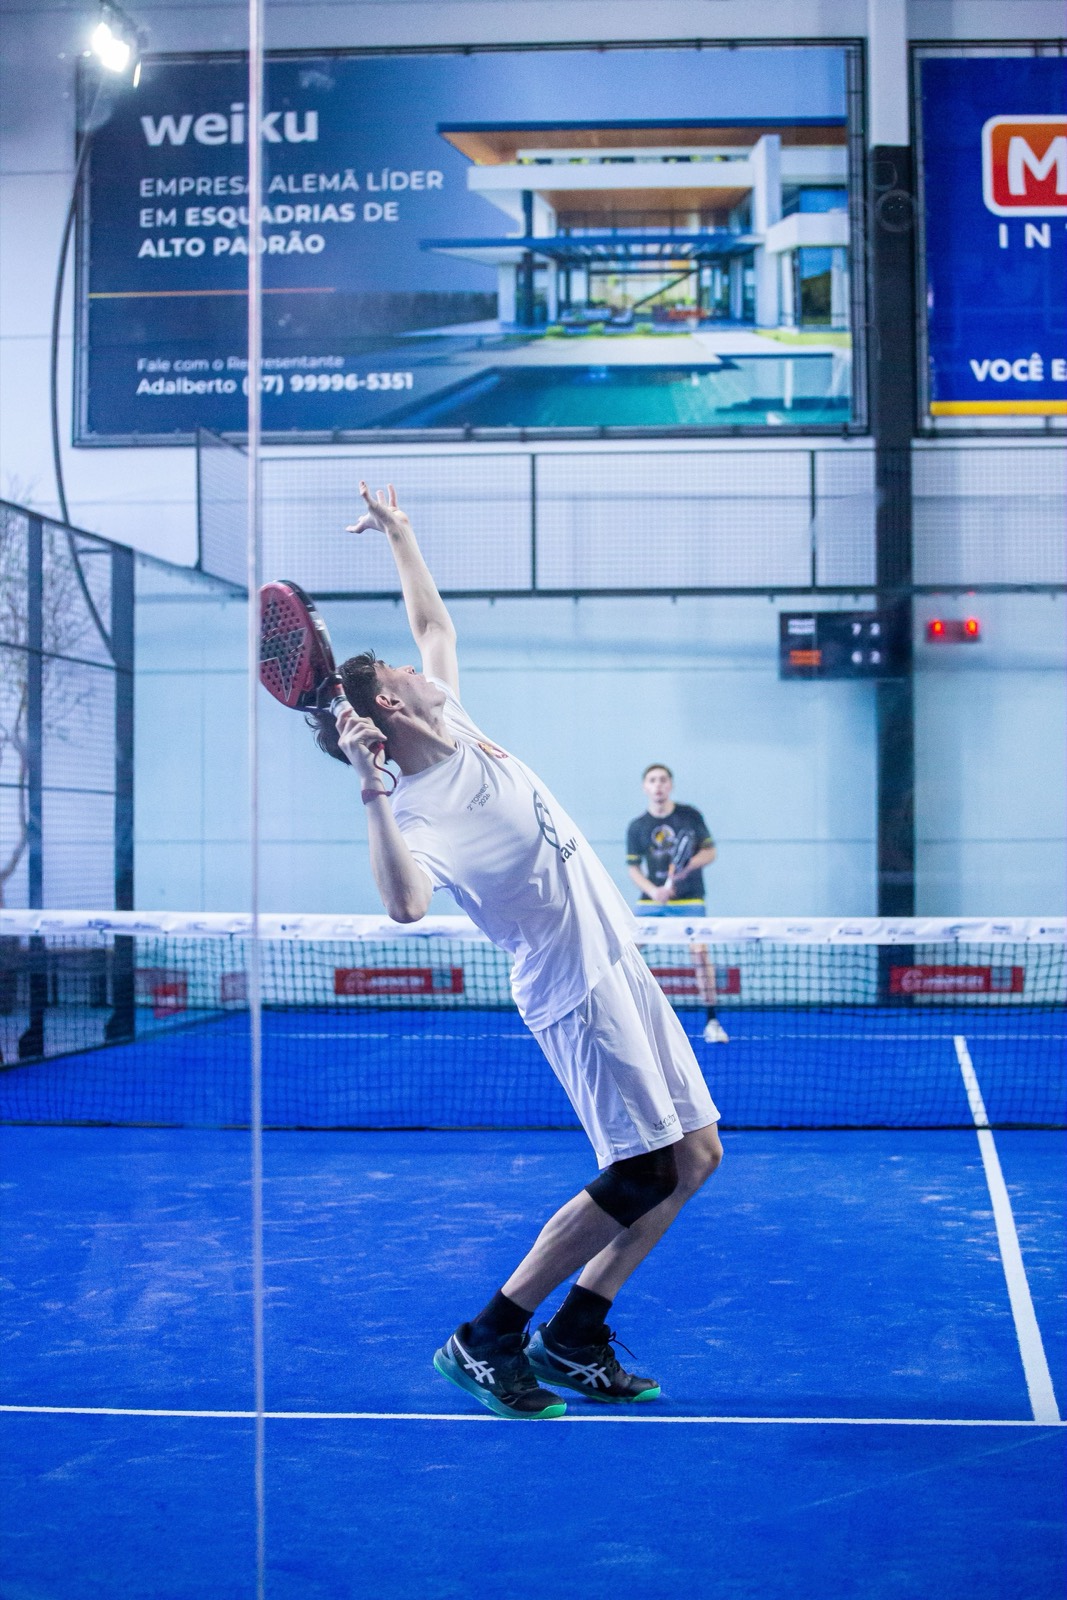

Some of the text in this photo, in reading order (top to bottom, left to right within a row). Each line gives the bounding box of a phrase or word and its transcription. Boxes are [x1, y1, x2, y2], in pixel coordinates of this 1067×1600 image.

[141, 103, 319, 146] weiku
[267, 168, 360, 194] ALEMÃ
[366, 168, 444, 193] LÍDER
[139, 202, 399, 229] EM ESQUADRIAS DE
[137, 237, 206, 259] ALTO
[998, 222, 1067, 249] IN
[136, 358, 171, 373] Fale
[173, 359, 209, 373] com
[212, 360, 224, 371] o
[969, 352, 1044, 382] VOCÊ
[136, 377, 236, 395] Adalberto
[289, 372, 415, 392] 99996-5351
[478, 793, 490, 807] 2026
